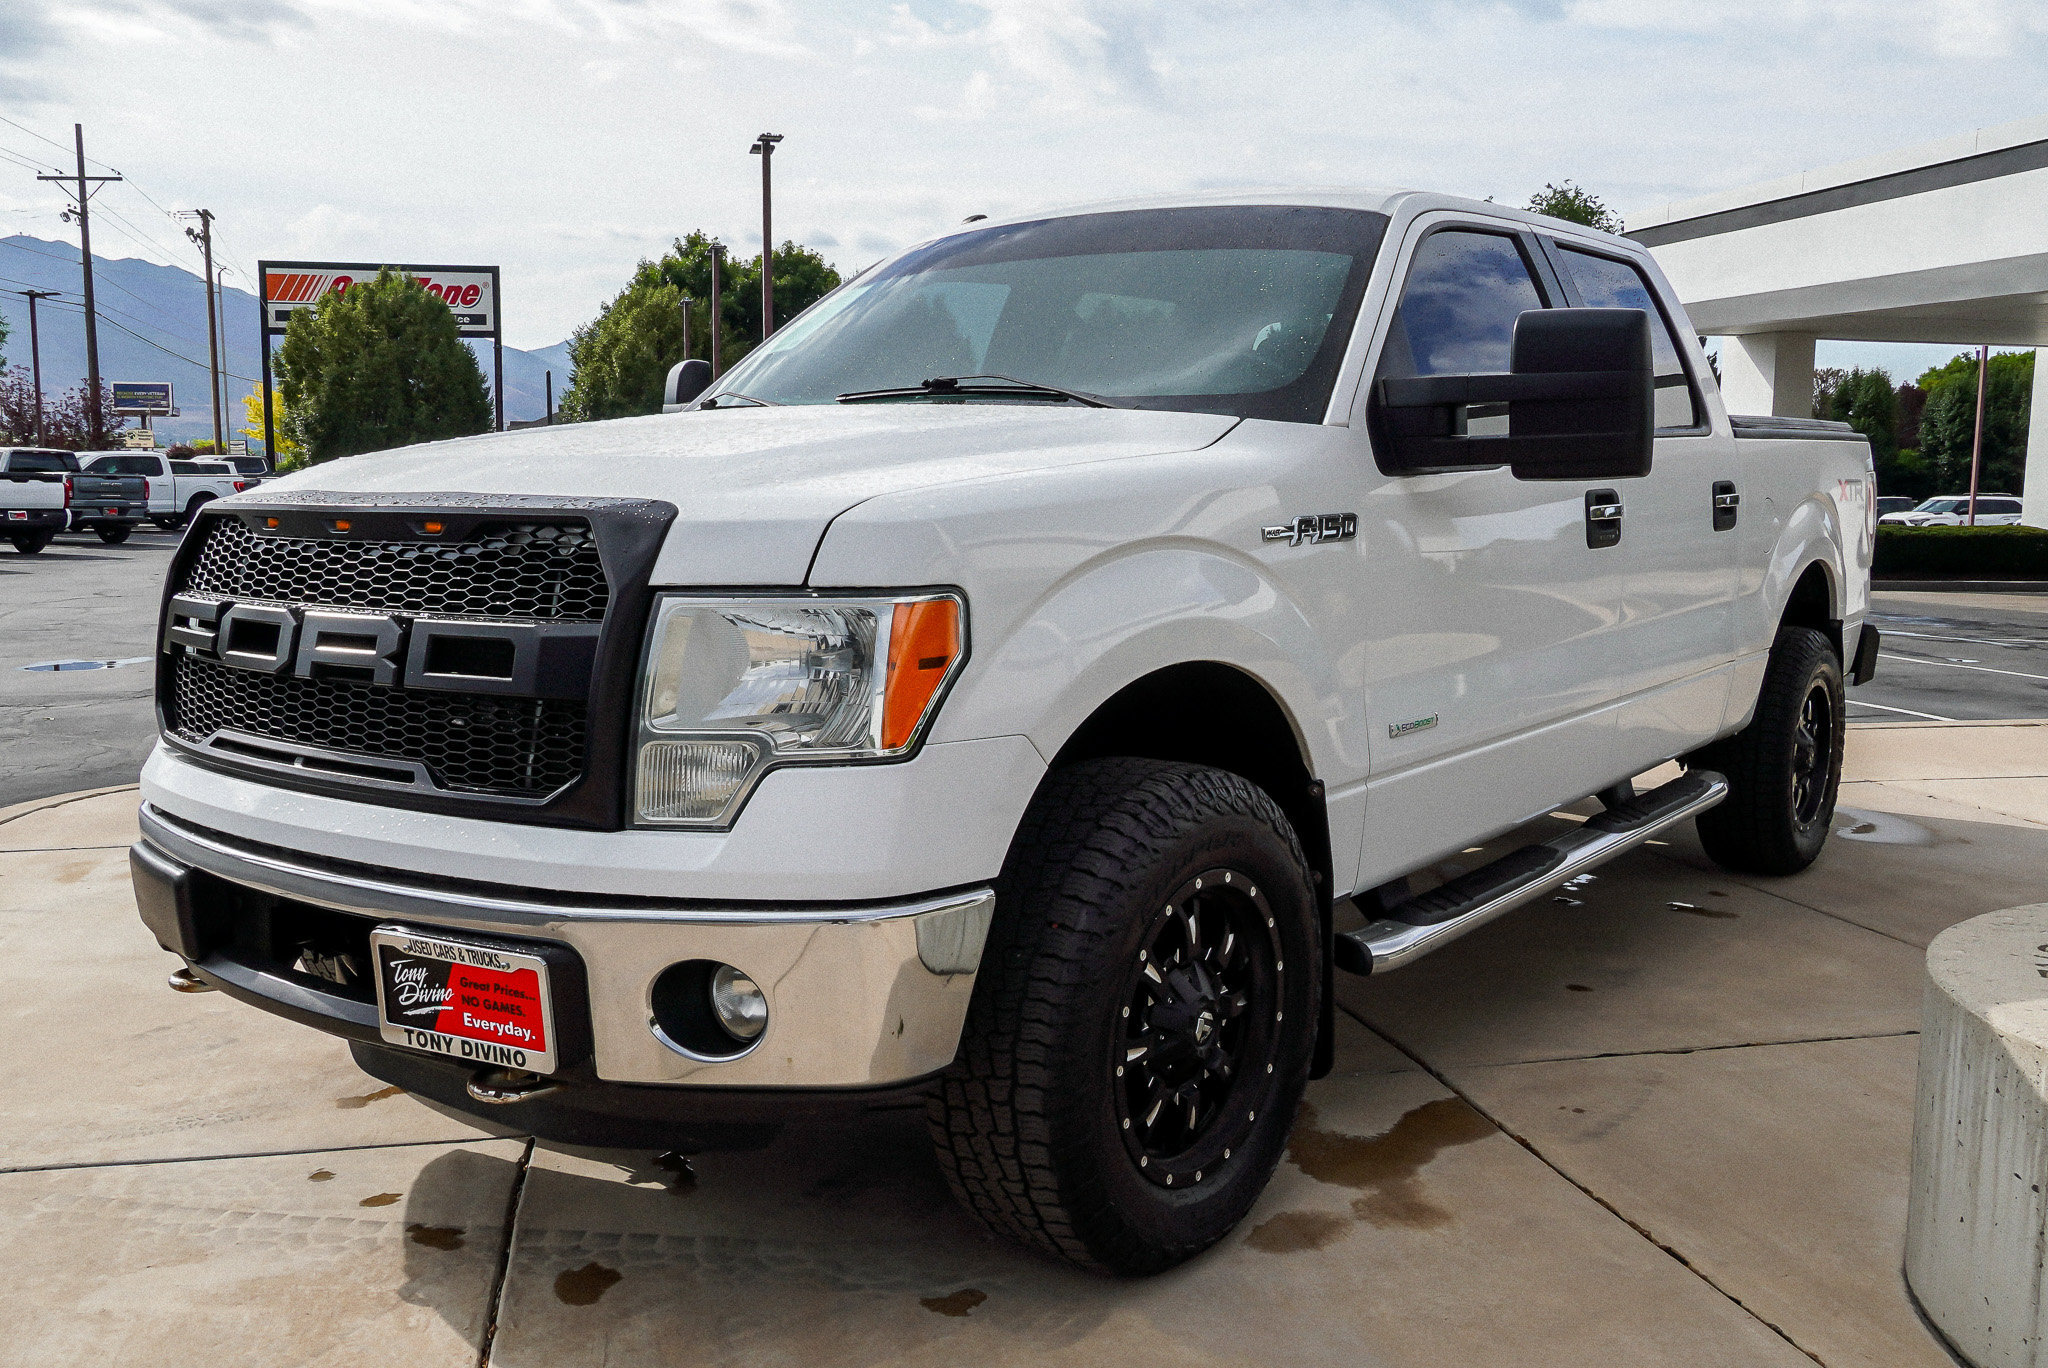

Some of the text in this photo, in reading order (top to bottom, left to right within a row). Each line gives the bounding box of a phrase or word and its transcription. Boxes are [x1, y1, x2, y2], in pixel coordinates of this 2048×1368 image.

[1837, 479, 1864, 501] XTR
[163, 592, 541, 698] FORD
[409, 939, 501, 969] USED CARS & TRUCKS
[390, 959, 429, 988] Tony
[393, 982, 455, 1006] Divino
[460, 976, 536, 1001] Great Prices...
[461, 994, 527, 1017] NO GAMES.
[463, 1012, 536, 1042] Everyday.
[404, 1029, 527, 1068] TONY DIVINO
